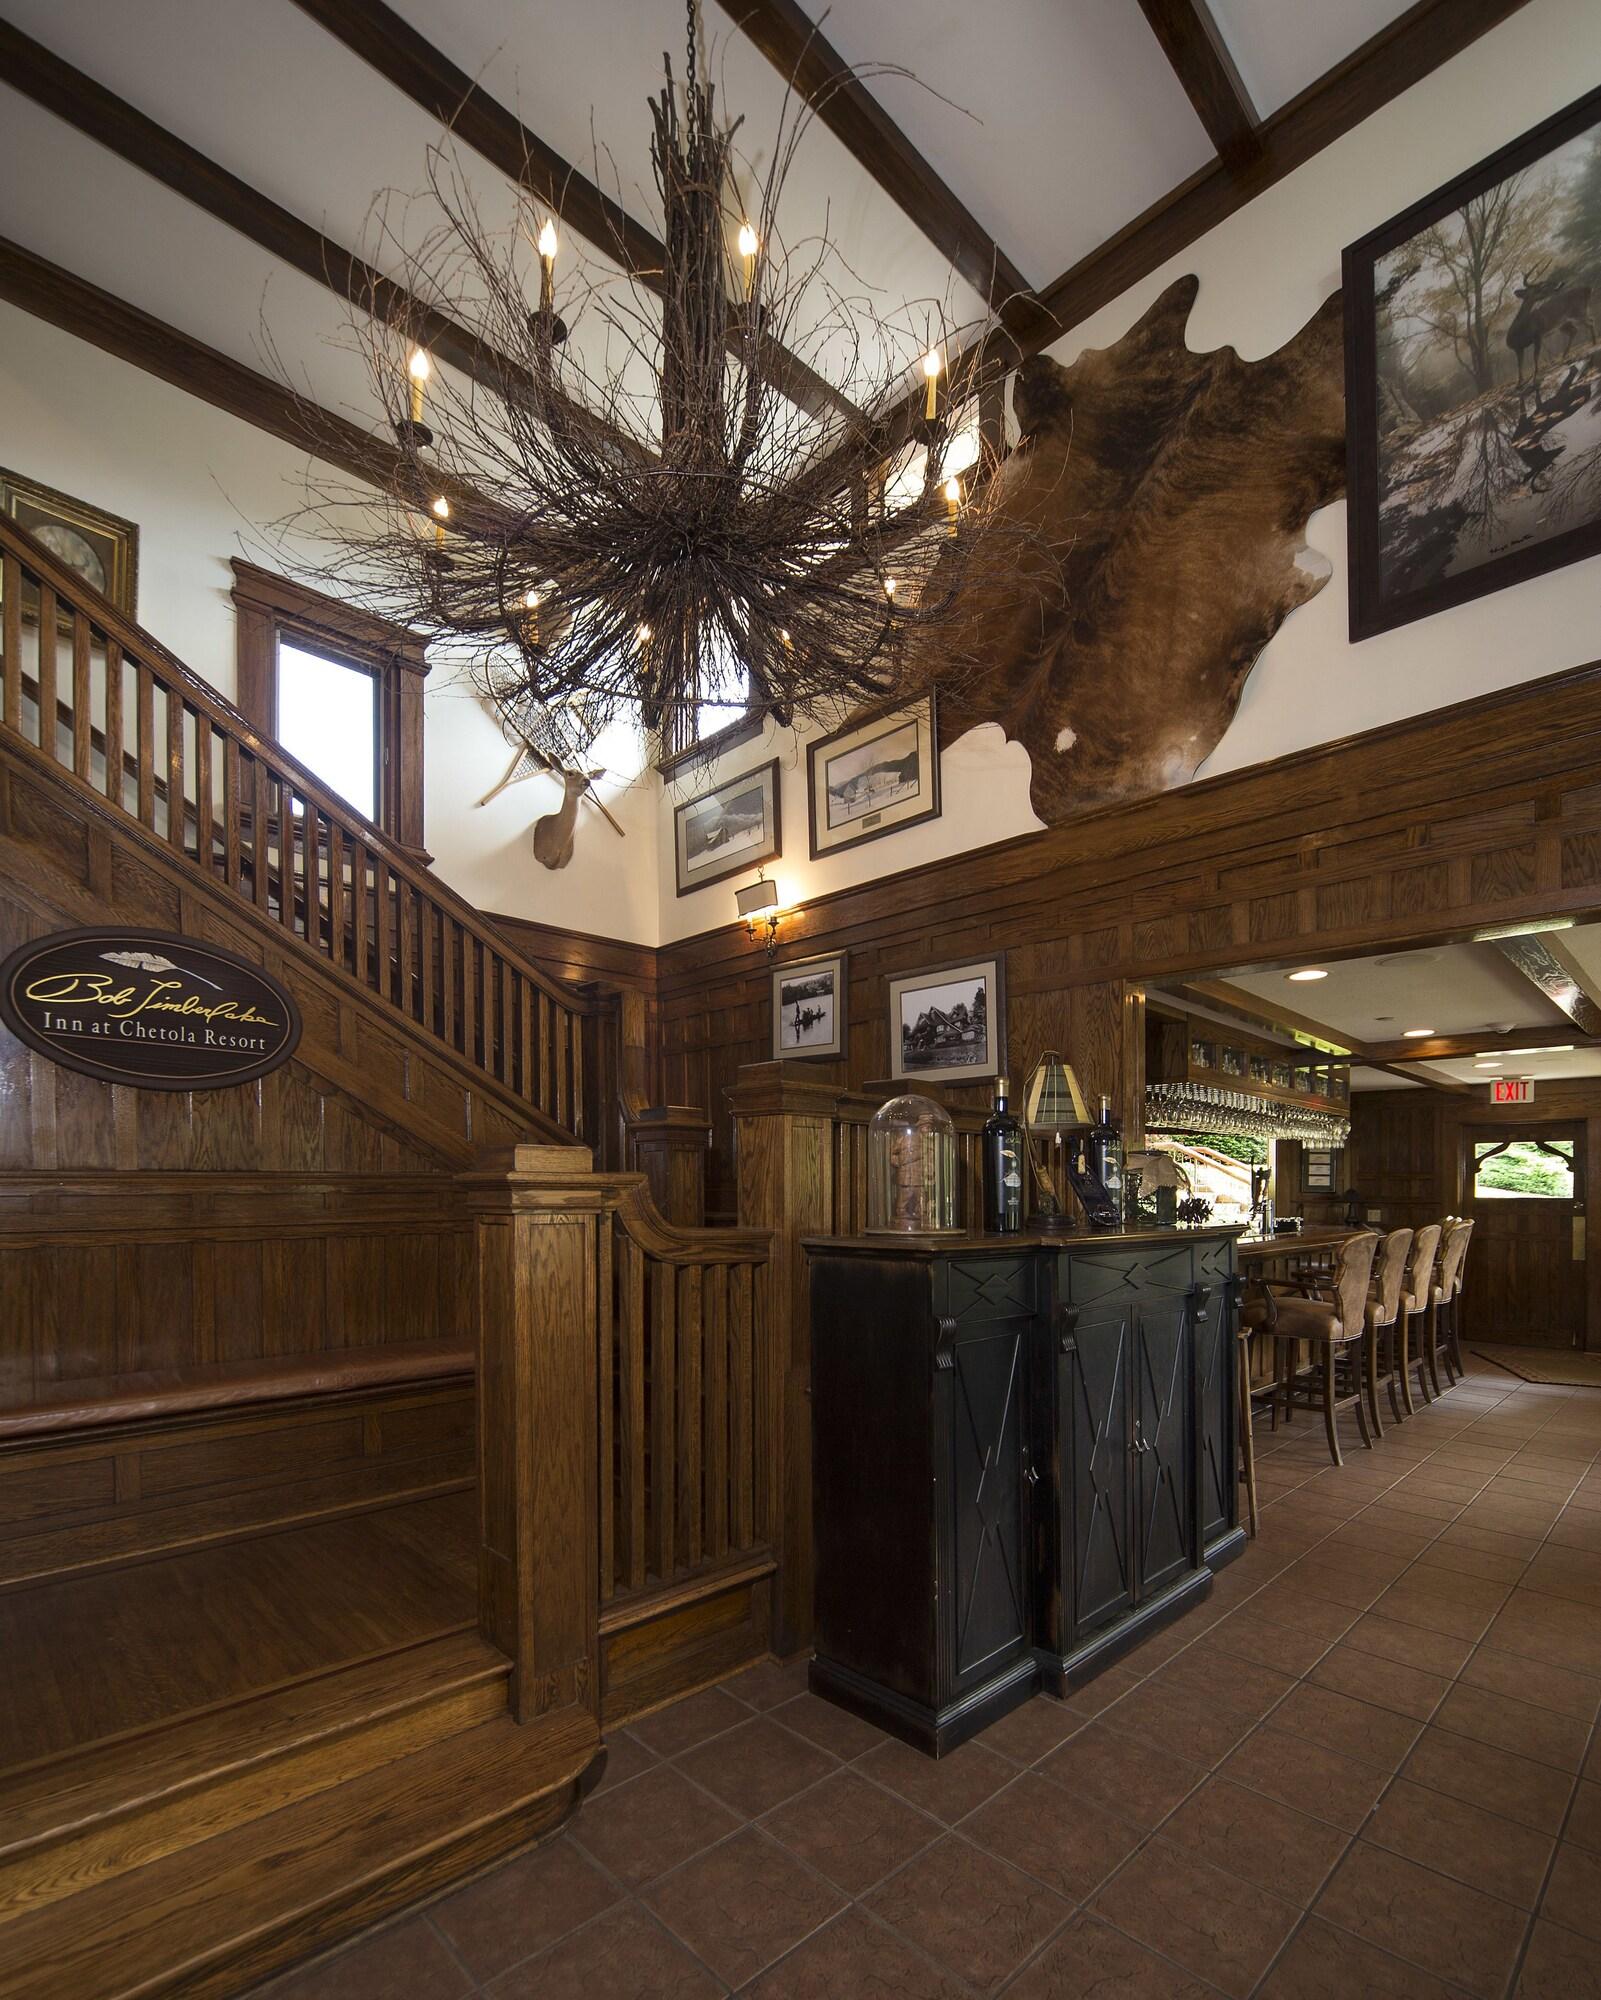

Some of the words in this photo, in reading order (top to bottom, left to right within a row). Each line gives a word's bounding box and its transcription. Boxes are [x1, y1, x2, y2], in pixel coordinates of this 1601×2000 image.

[26, 973, 136, 1005] Bob
[107, 979, 280, 1027] Timberlake
[43, 1012, 83, 1032] Inn
[91, 1022, 111, 1034] at
[120, 1020, 196, 1043] Chetola
[204, 1029, 265, 1050] Resort
[1495, 1081, 1529, 1101] EXIT
